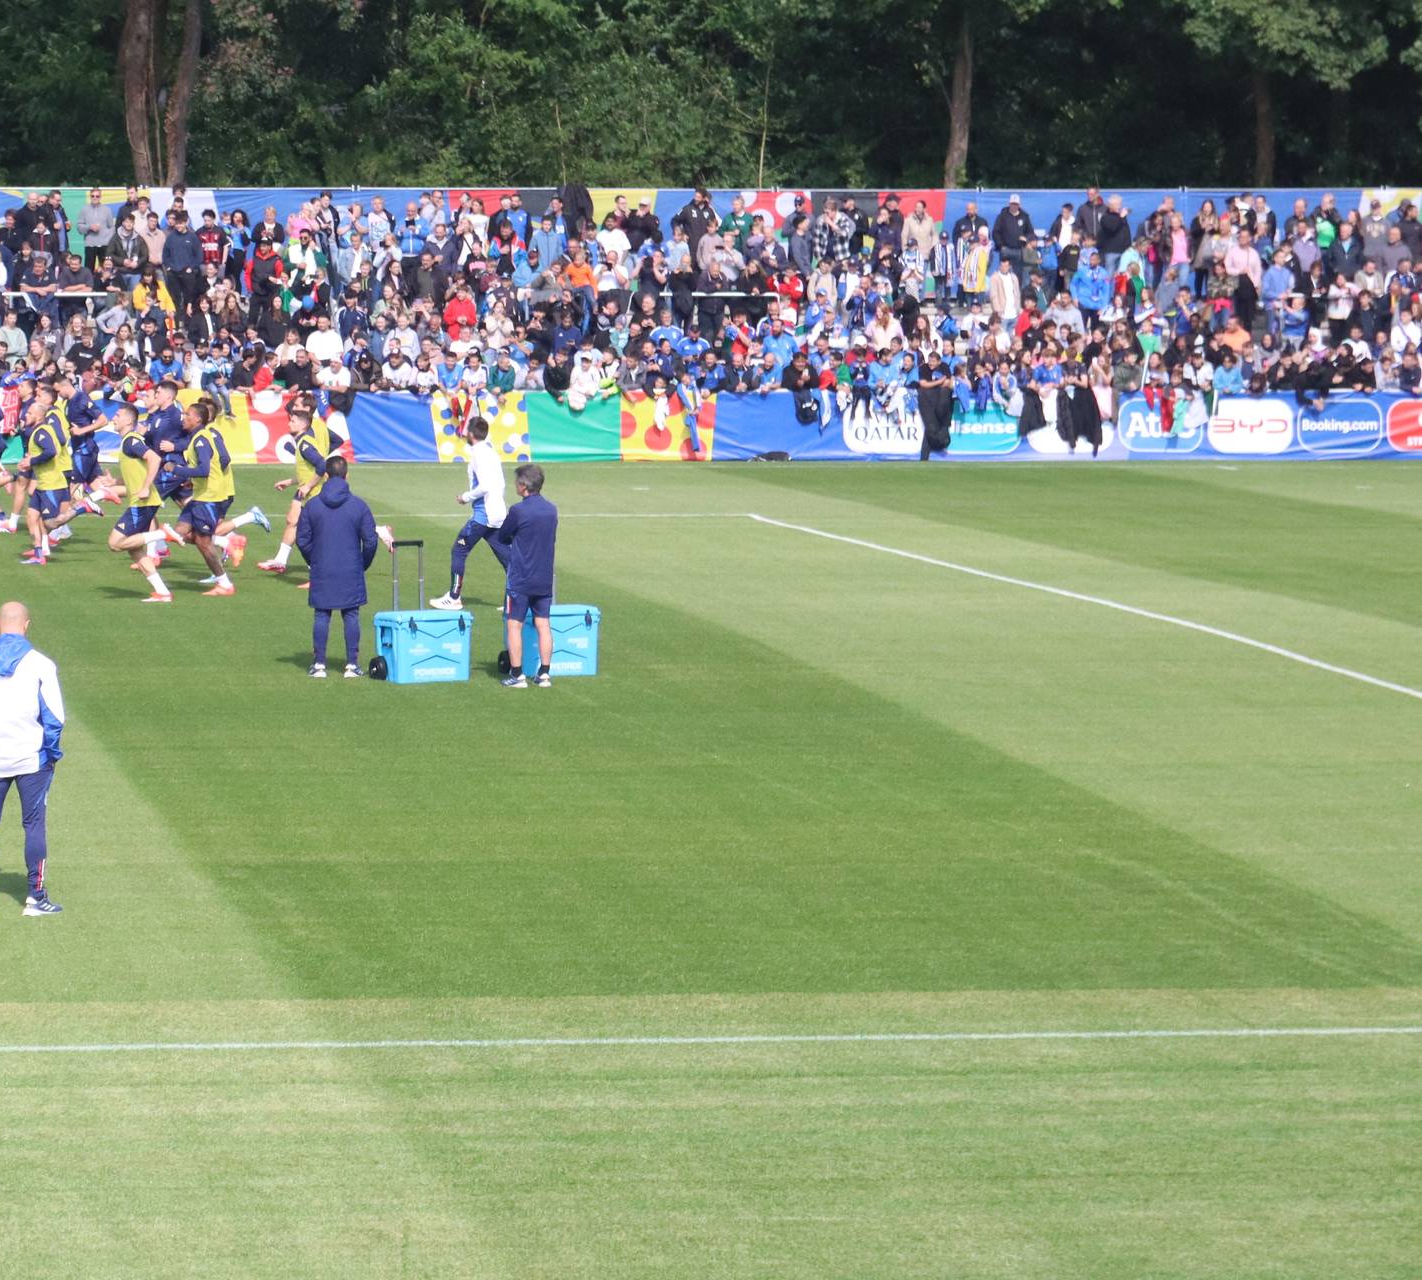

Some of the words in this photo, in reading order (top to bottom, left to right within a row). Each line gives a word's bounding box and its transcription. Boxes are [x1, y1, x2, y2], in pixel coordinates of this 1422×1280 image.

[1213, 418, 1288, 433] BYD
[1301, 418, 1378, 433] Booking.com
[854, 426, 919, 442] QATAR
